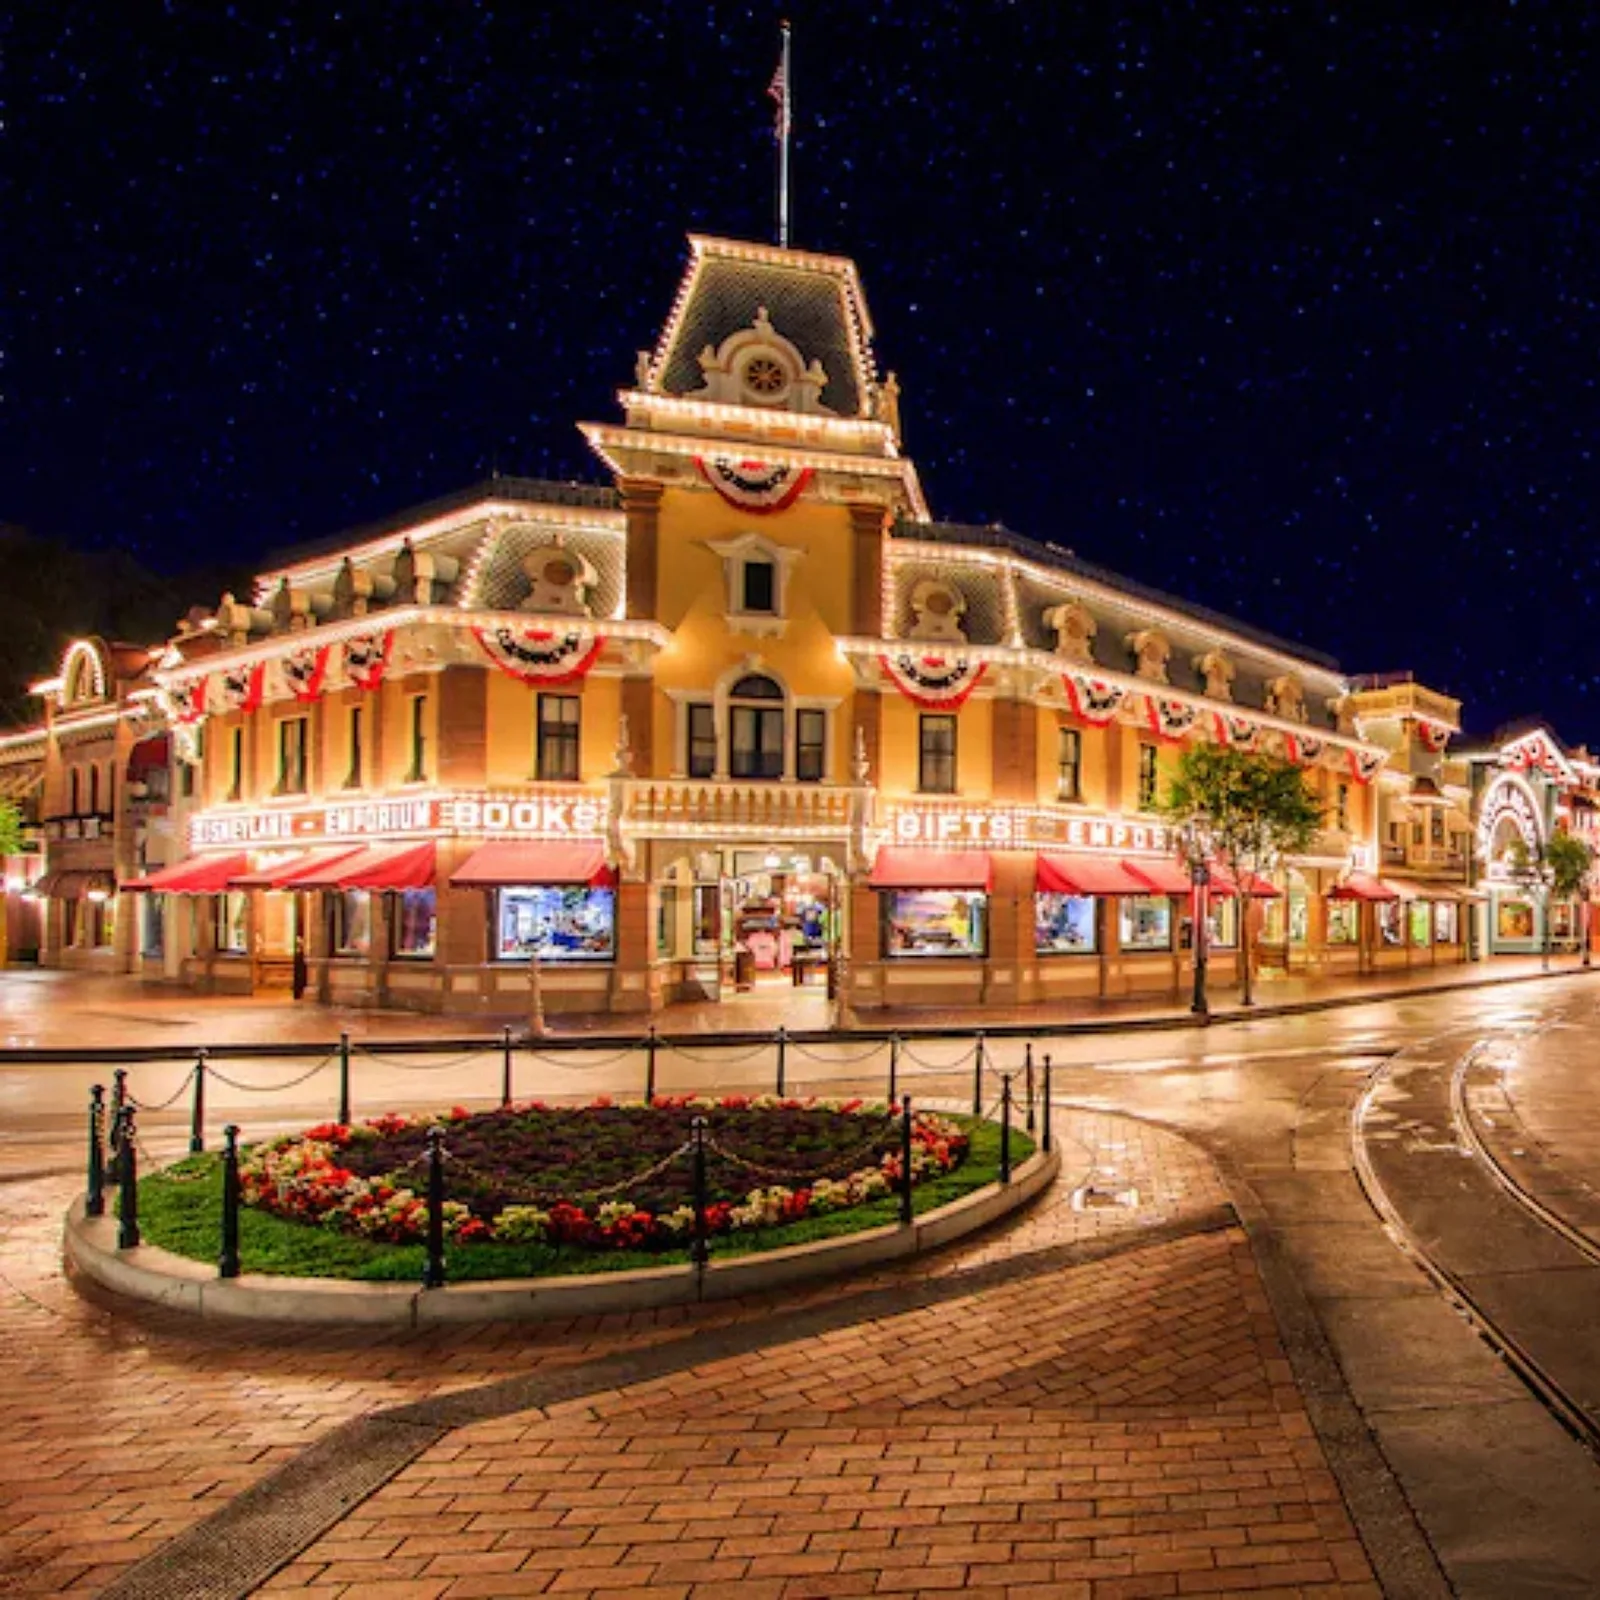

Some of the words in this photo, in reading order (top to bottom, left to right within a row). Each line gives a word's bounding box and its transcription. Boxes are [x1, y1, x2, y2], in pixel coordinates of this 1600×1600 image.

[323, 800, 432, 836] EMPORIUM
[453, 801, 599, 834] BOOKS
[897, 813, 1013, 841] GIFTS
[1068, 821, 1200, 850] EMPOR
